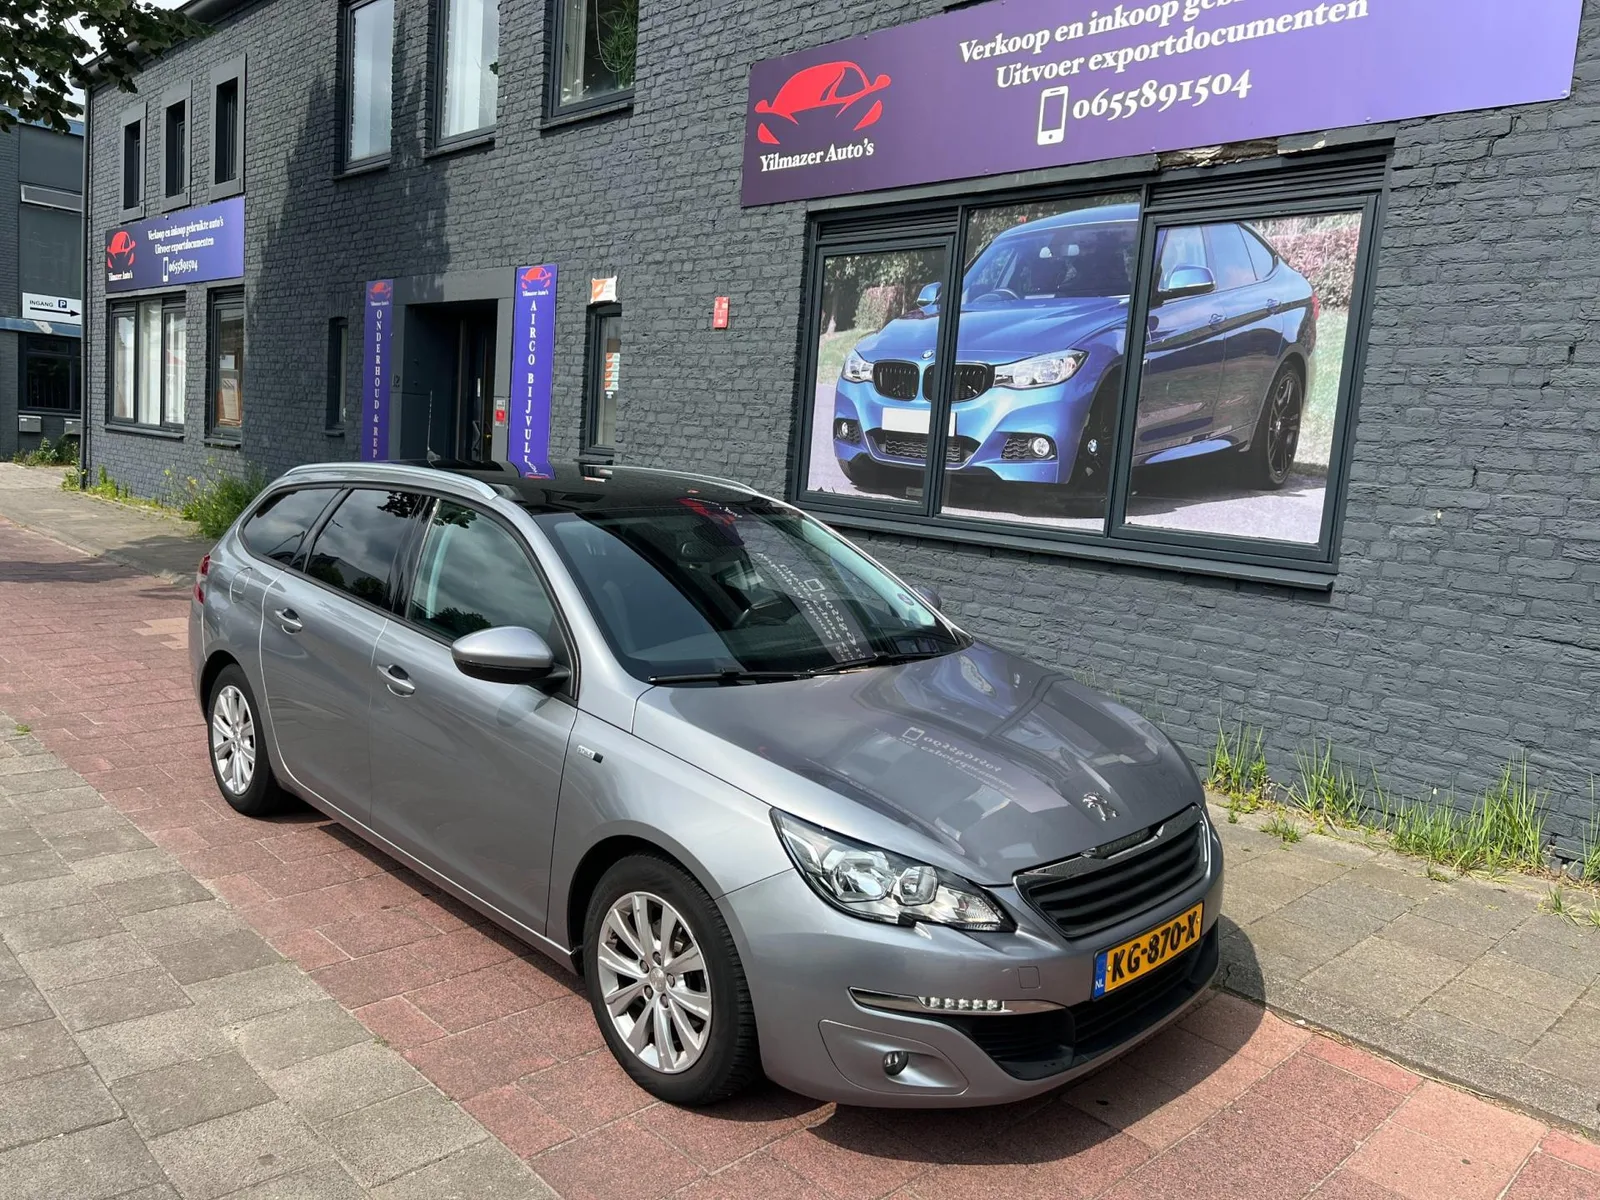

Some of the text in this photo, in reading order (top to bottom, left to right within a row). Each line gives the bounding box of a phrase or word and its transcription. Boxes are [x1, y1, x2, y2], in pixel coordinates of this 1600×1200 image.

[960, 28, 1050, 63] Verkoop
[1054, 22, 1084, 41] en
[1088, 1, 1179, 38] inkoop
[996, 0, 1368, 88] Uitvoer exportdocumenten
[1072, 69, 1252, 121] 0655891504
[760, 138, 875, 172] Yilmazer Auto's
[528, 300, 537, 365] AIRCO
[373, 413, 379, 423] &
[1095, 910, 1197, 988] NL KG-870-X
